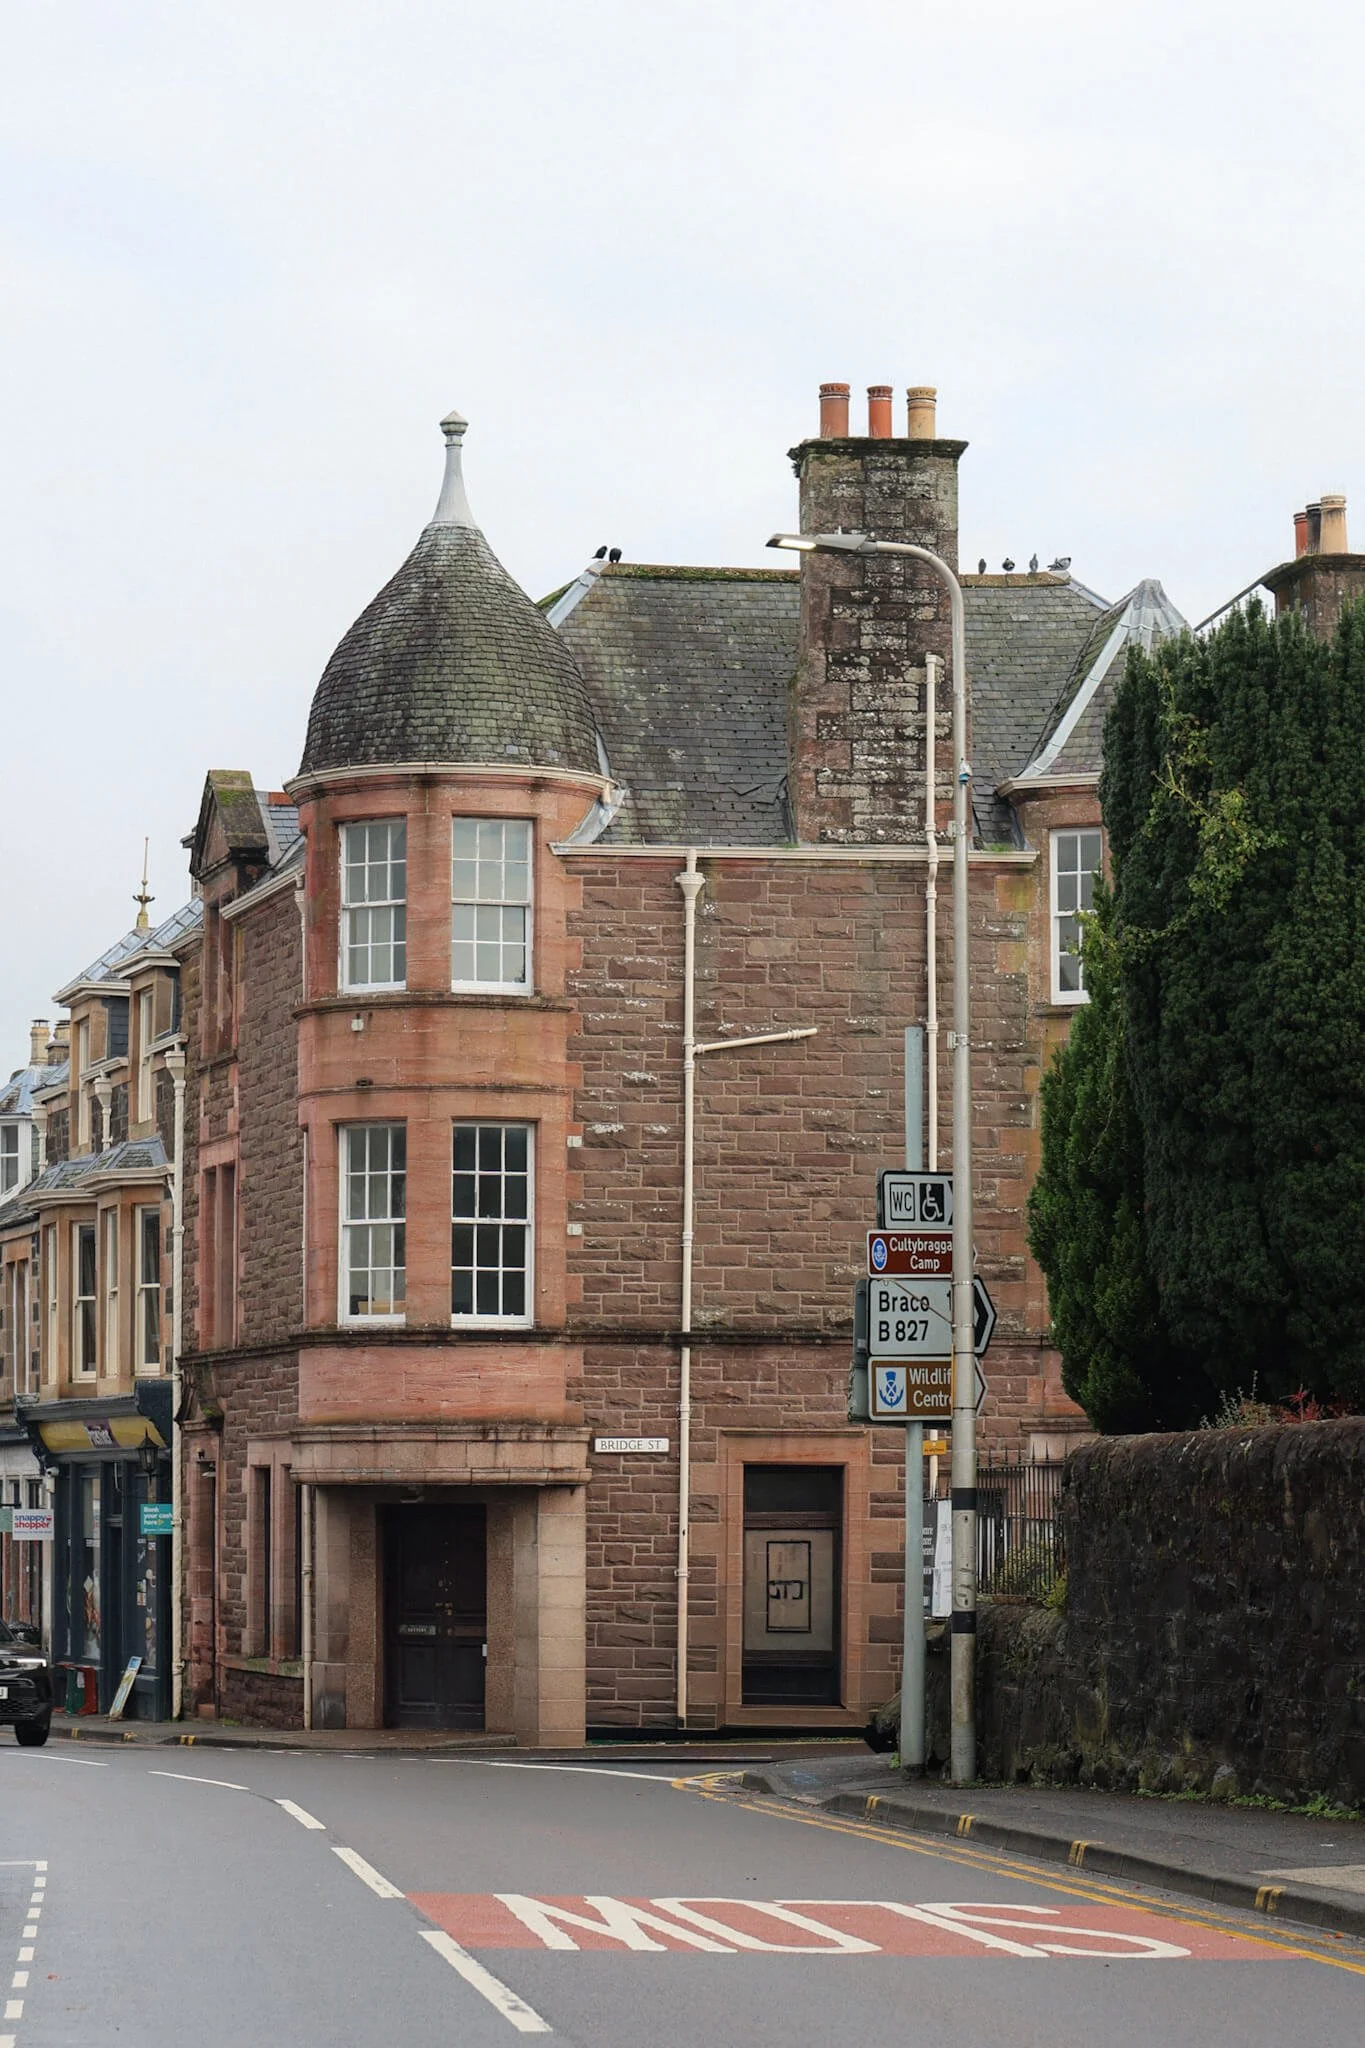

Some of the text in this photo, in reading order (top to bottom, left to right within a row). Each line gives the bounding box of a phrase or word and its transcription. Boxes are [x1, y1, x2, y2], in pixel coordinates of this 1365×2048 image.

[893, 1191, 912, 1212] WC
[889, 1237, 952, 1254] Cultybragga
[910, 1255, 940, 1271] Camp
[878, 1291, 930, 1312] Braco
[878, 1320, 929, 1342] B 827
[909, 1367, 952, 1385] Wildlif
[600, 1440, 643, 1450] BRIDGE
[15, 1521, 49, 1529] shopper
